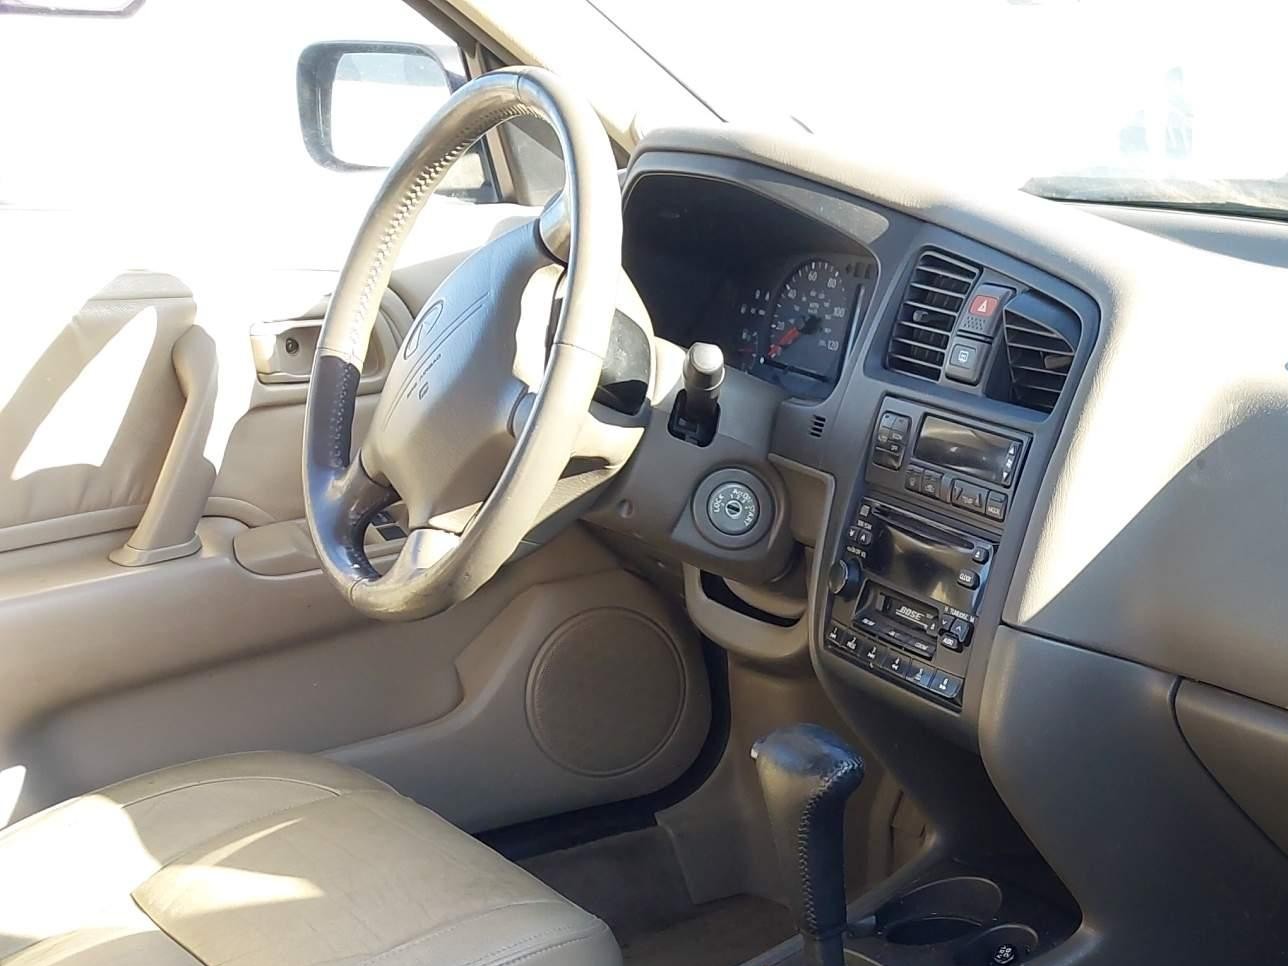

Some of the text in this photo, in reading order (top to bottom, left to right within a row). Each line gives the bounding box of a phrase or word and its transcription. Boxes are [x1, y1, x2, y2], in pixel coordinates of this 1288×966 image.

[808, 271, 818, 281] 60
[827, 278, 837, 288] 80
[787, 289, 797, 299] 40
[833, 307, 845, 318] 100
[827, 340, 839, 351] 120
[713, 493, 725, 513] LOCK
[897, 606, 925, 621] BOSE
